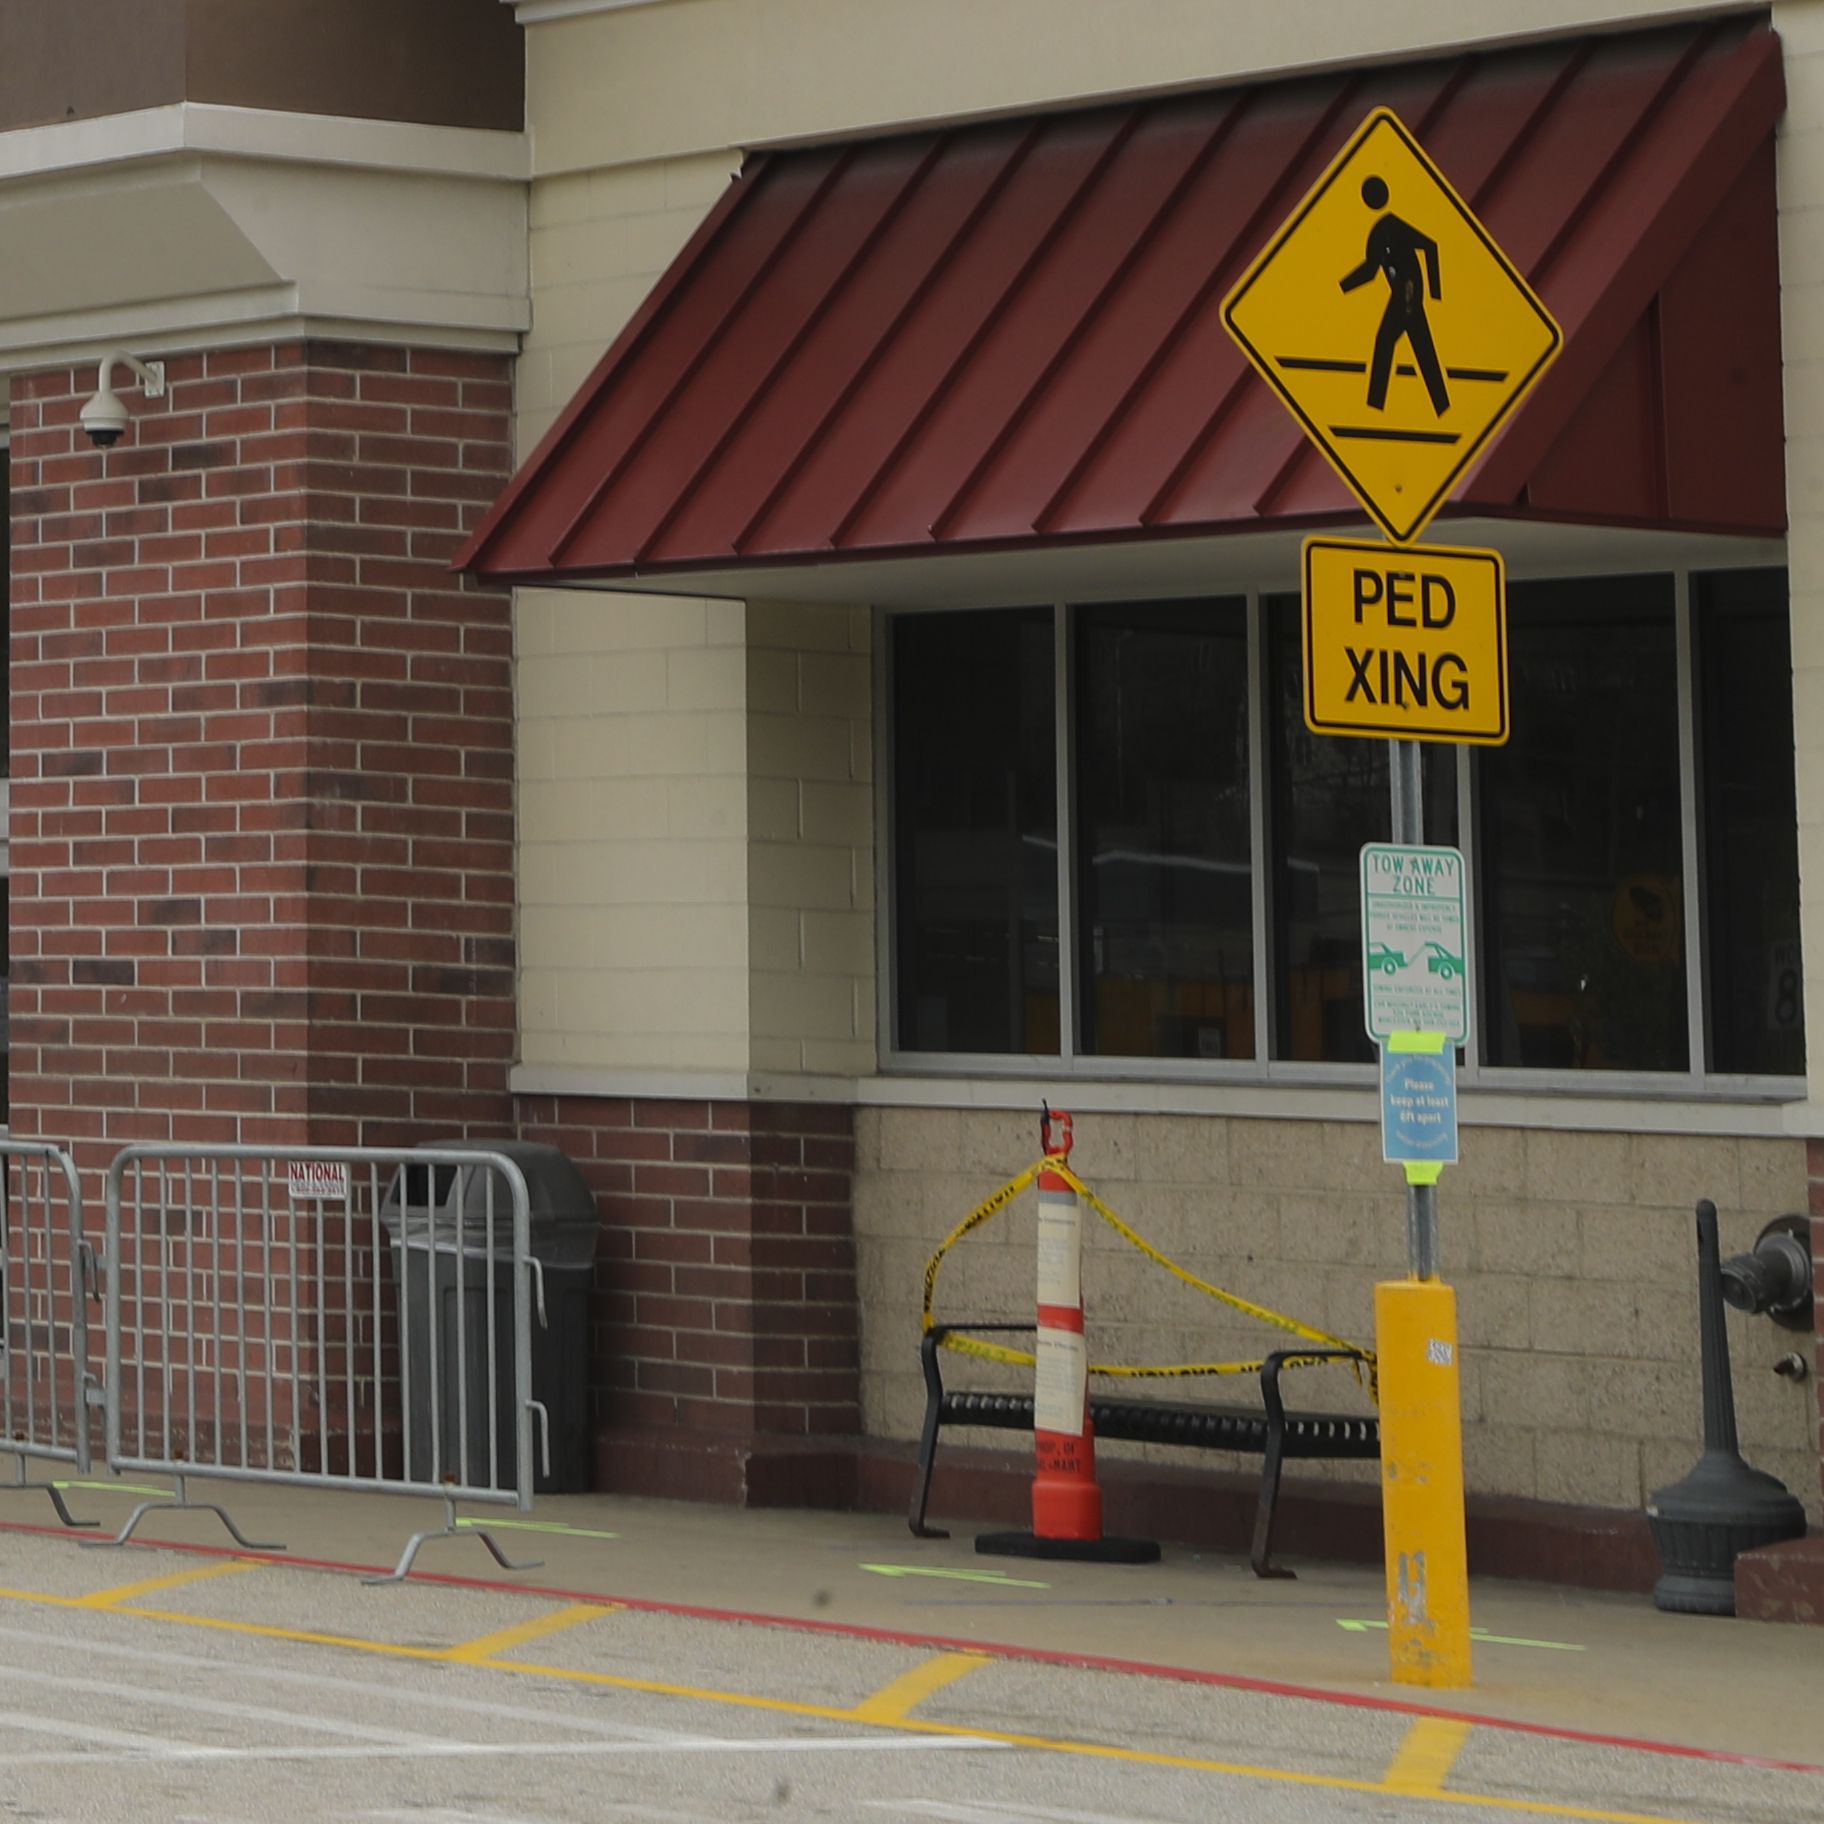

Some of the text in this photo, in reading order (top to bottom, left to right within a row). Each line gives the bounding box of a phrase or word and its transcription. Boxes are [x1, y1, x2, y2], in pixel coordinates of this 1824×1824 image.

[1353, 568, 1456, 630] PED
[1344, 646, 1469, 711] XING
[1372, 855, 1454, 876] TOW AWAY
[1393, 875, 1436, 896] ZONE
[1404, 1078, 1434, 1091] Please
[1390, 1095, 1414, 1108] keep
[1427, 1096, 1449, 1107] least
[1417, 1112, 1441, 1126] apart
[291, 1162, 345, 1181] NATIONAL
